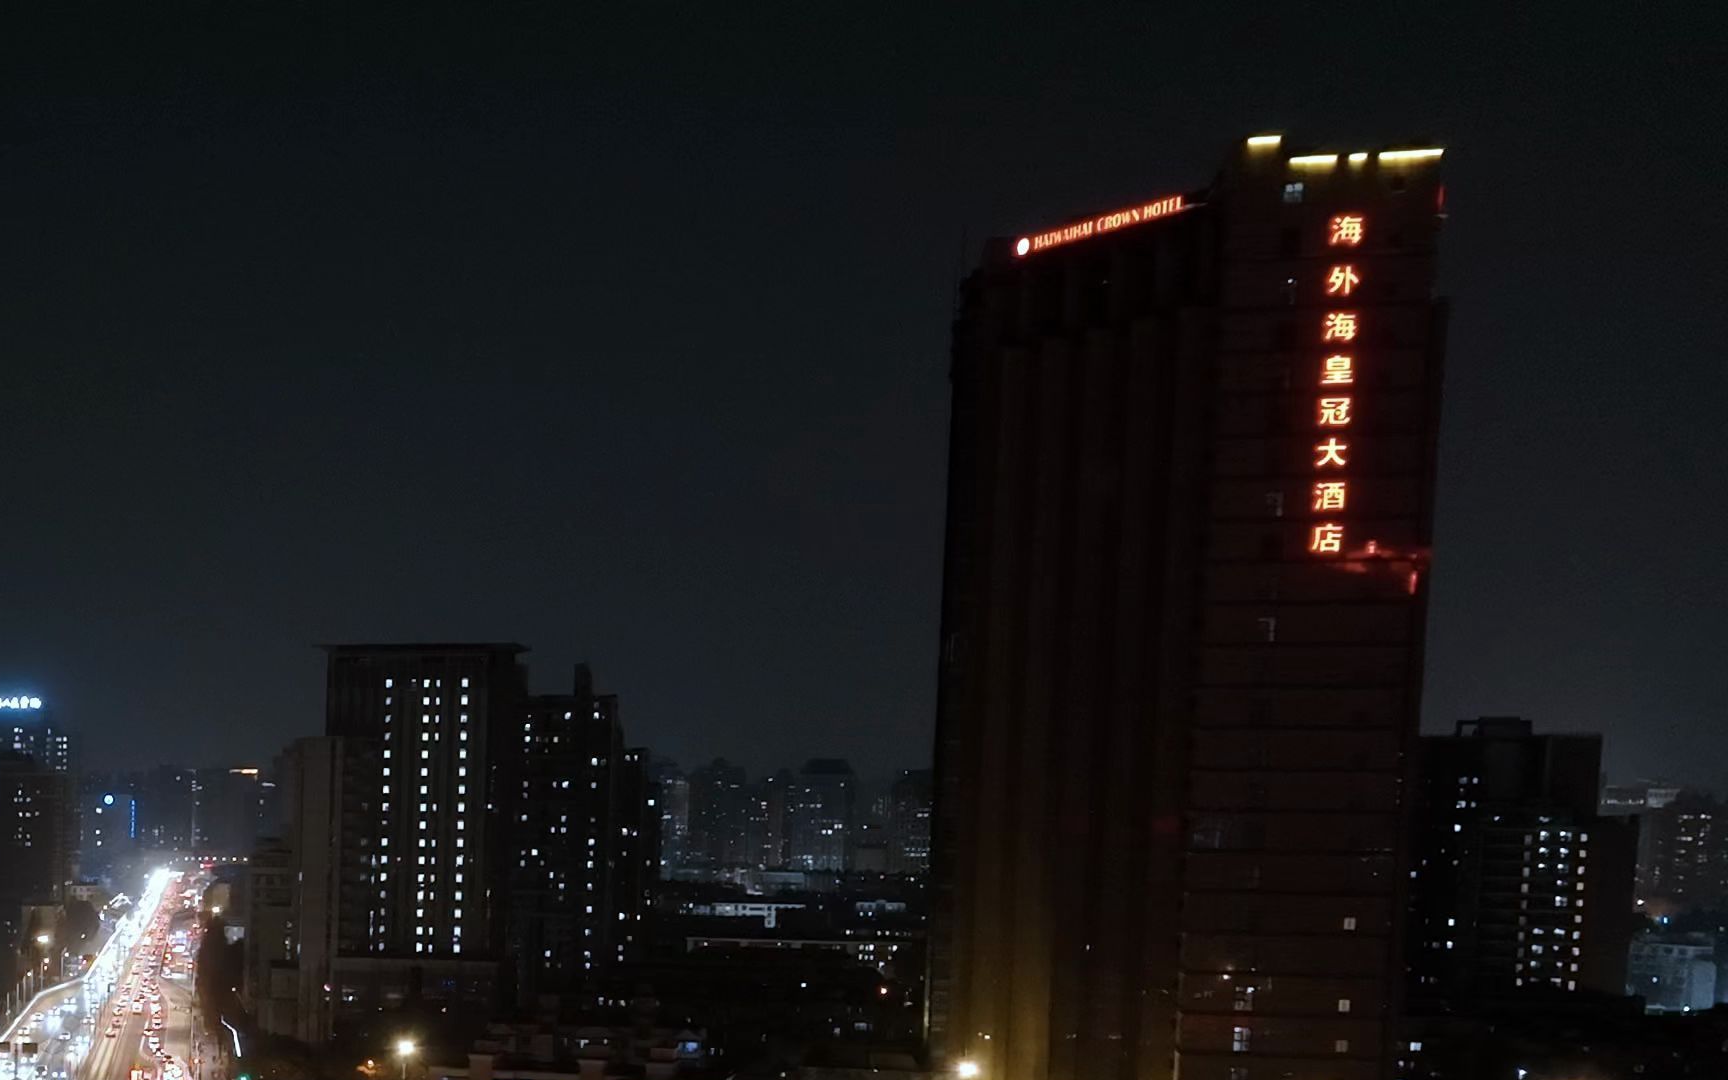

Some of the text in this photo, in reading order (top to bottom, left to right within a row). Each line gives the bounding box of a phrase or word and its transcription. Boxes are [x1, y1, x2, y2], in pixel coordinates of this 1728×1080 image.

[1033, 196, 1183, 250] HAIWAIHAI CROWN HOTEL
[1311, 215, 1364, 553] 海外海皇冠大酒店
